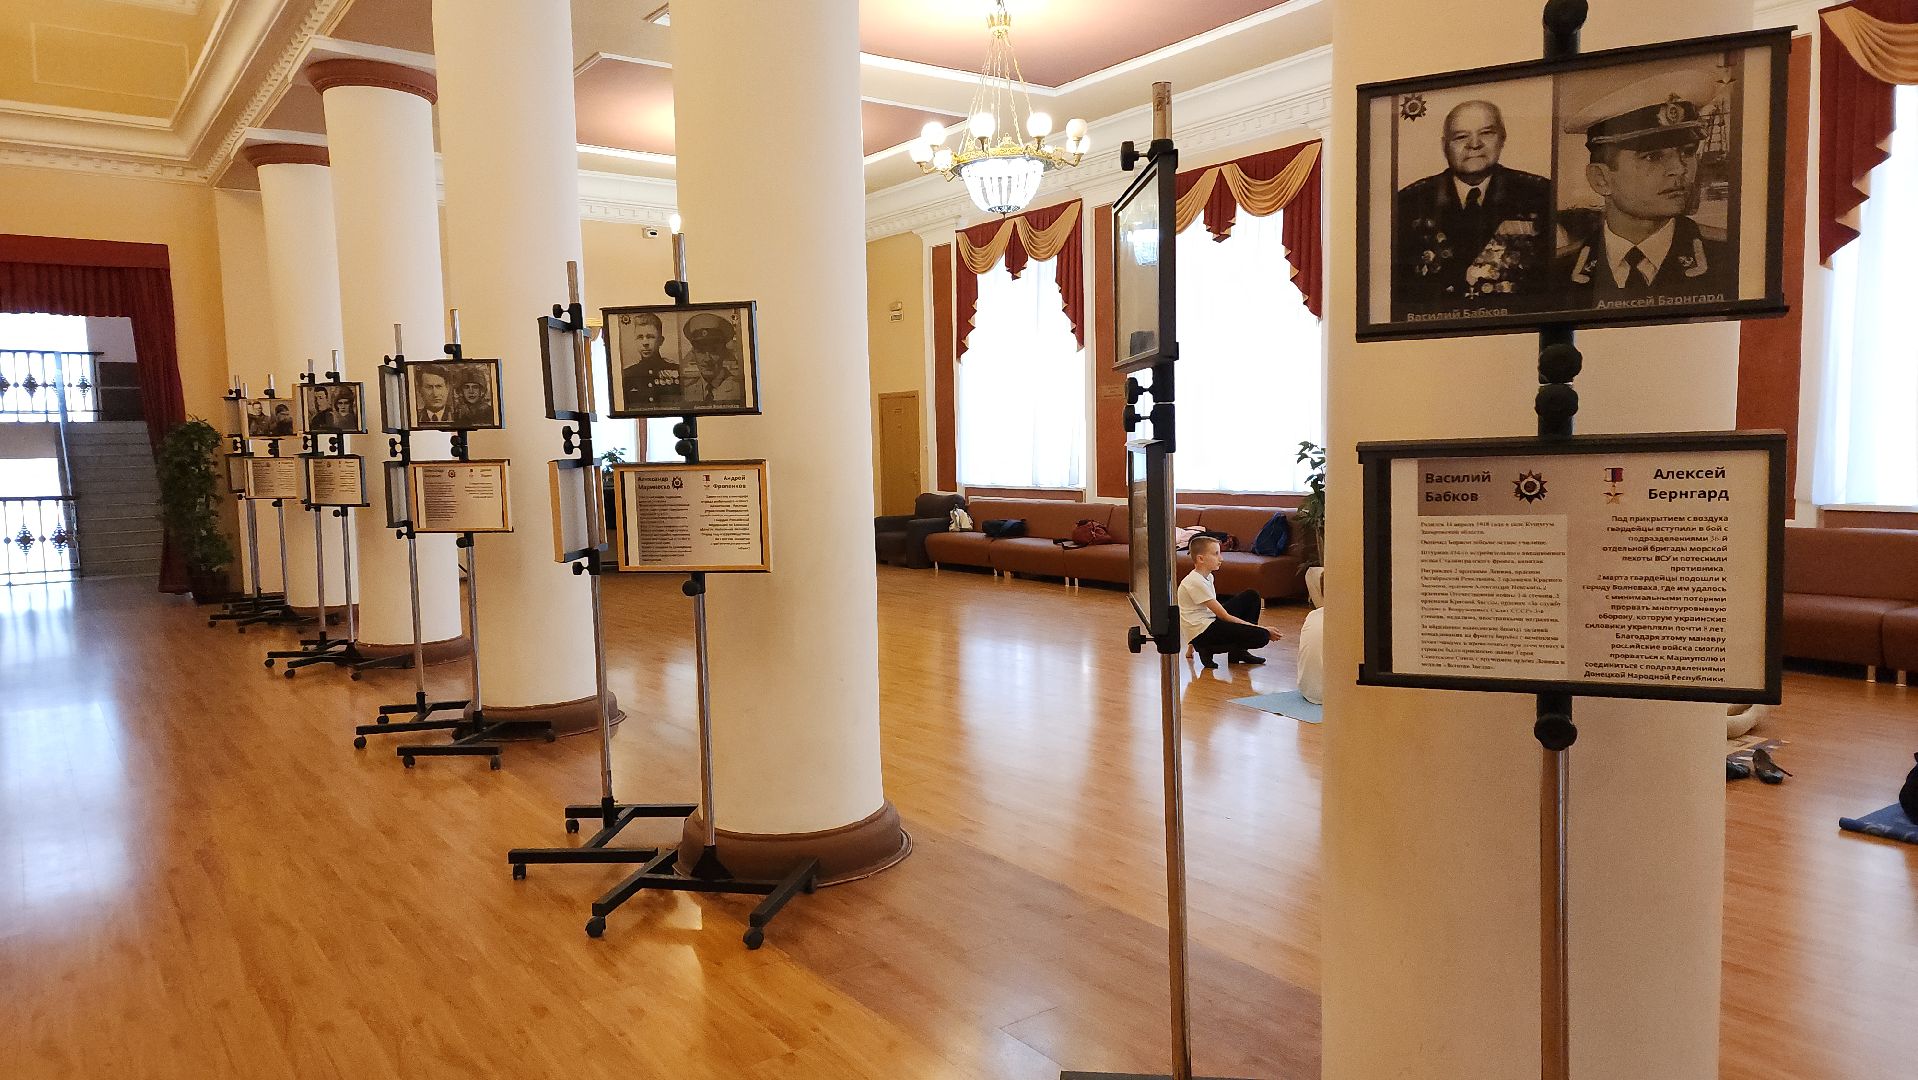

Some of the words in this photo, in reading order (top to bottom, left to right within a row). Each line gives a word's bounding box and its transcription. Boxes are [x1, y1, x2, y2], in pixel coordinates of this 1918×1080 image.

[1596, 296, 1655, 310] Алексей
[1407, 309, 1460, 322] Василий
[1463, 307, 1508, 319] Бабков
[1425, 471, 1491, 483] Василий
[1653, 467, 1726, 480] Алексей
[1425, 491, 1479, 502] Бабков
[1648, 488, 1730, 502] Бернгард
